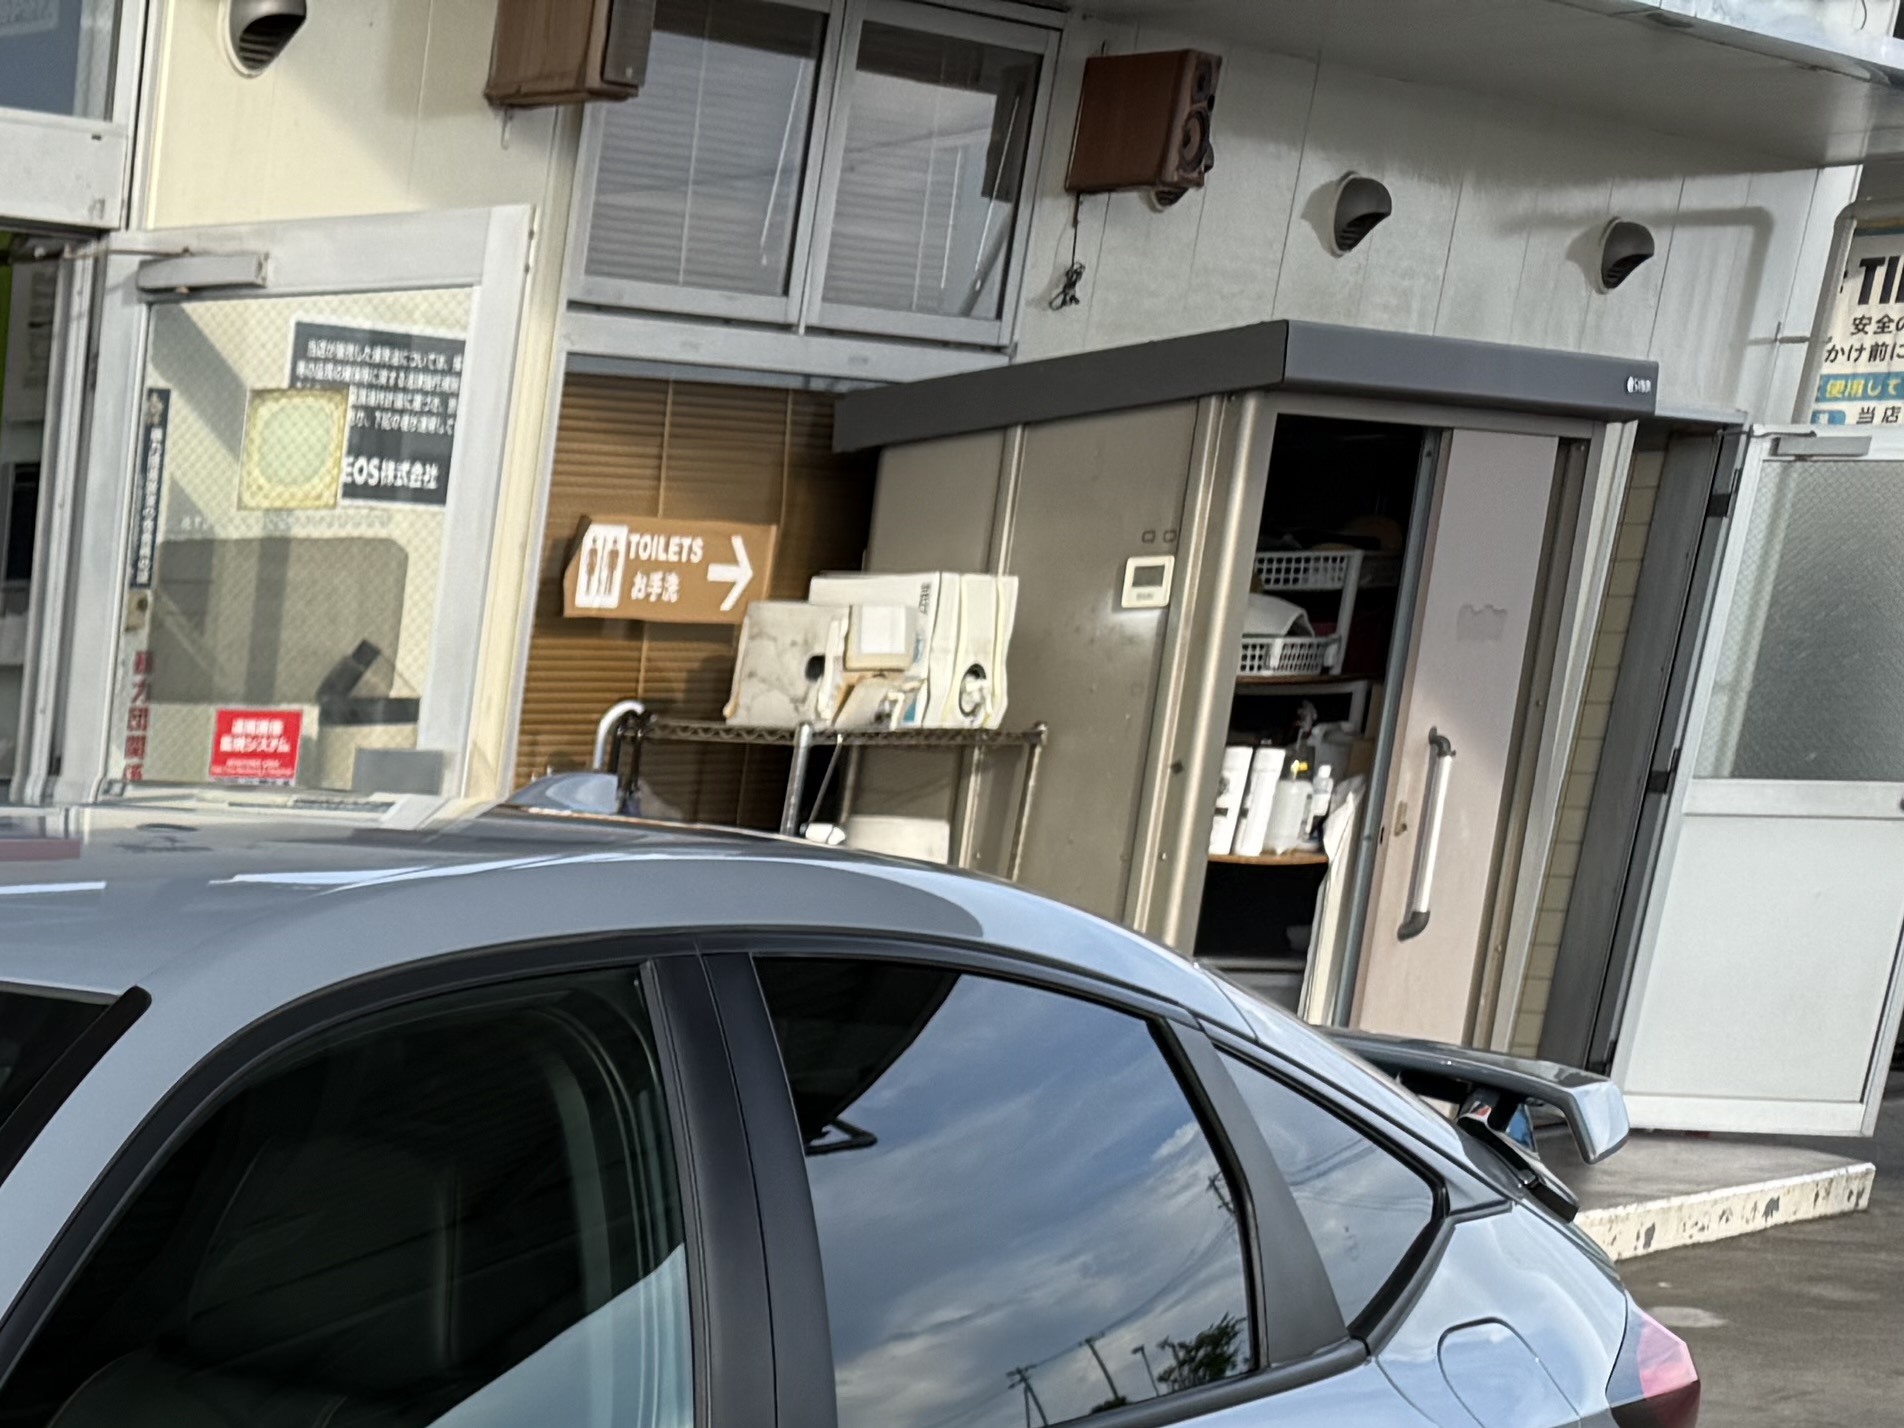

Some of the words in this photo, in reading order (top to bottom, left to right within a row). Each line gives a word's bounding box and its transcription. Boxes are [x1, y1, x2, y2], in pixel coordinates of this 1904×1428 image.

[629, 533, 704, 564] TOILETS
[631, 570, 680, 603] お手洗
